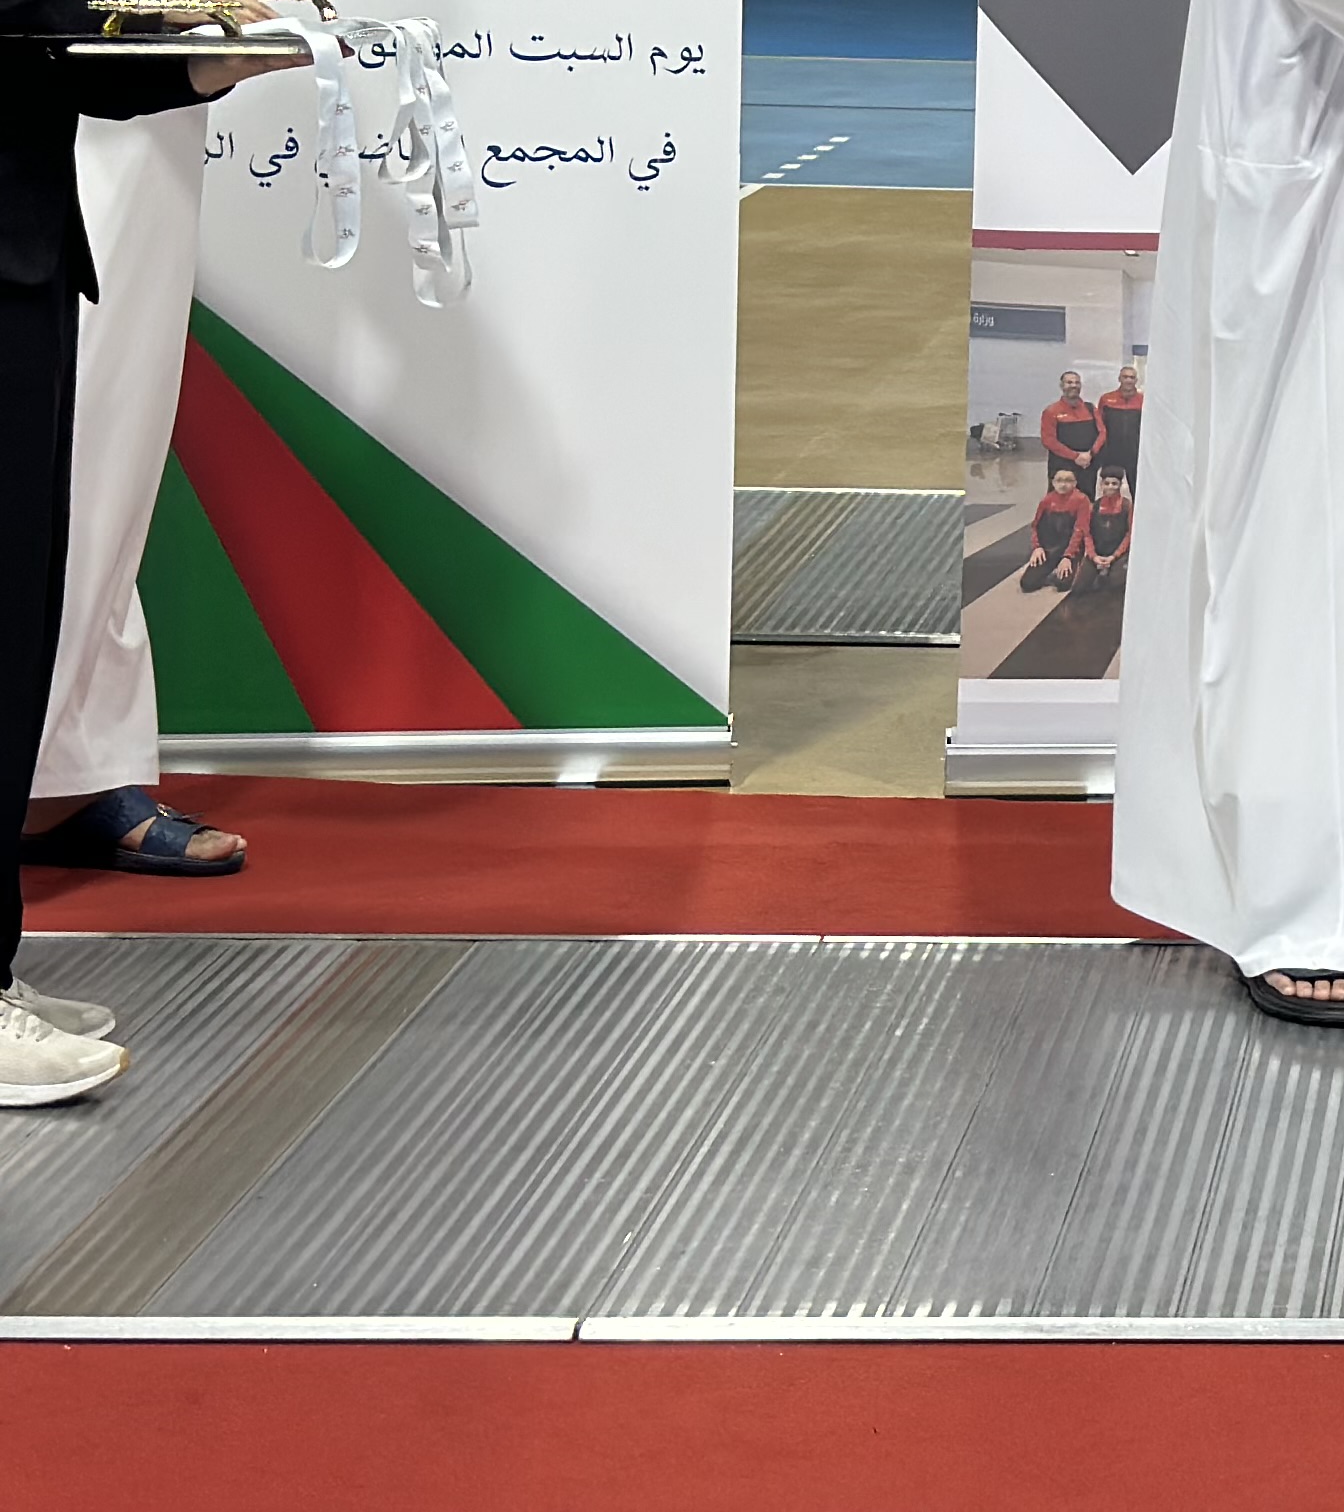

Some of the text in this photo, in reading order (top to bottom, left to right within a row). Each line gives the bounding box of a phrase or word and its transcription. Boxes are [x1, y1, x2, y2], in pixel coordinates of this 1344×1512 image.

[508, 33, 633, 73] السبت
[649, 41, 705, 76] يوم
[249, 127, 299, 188] في
[482, 136, 613, 188] المجمع
[628, 133, 676, 193] في
